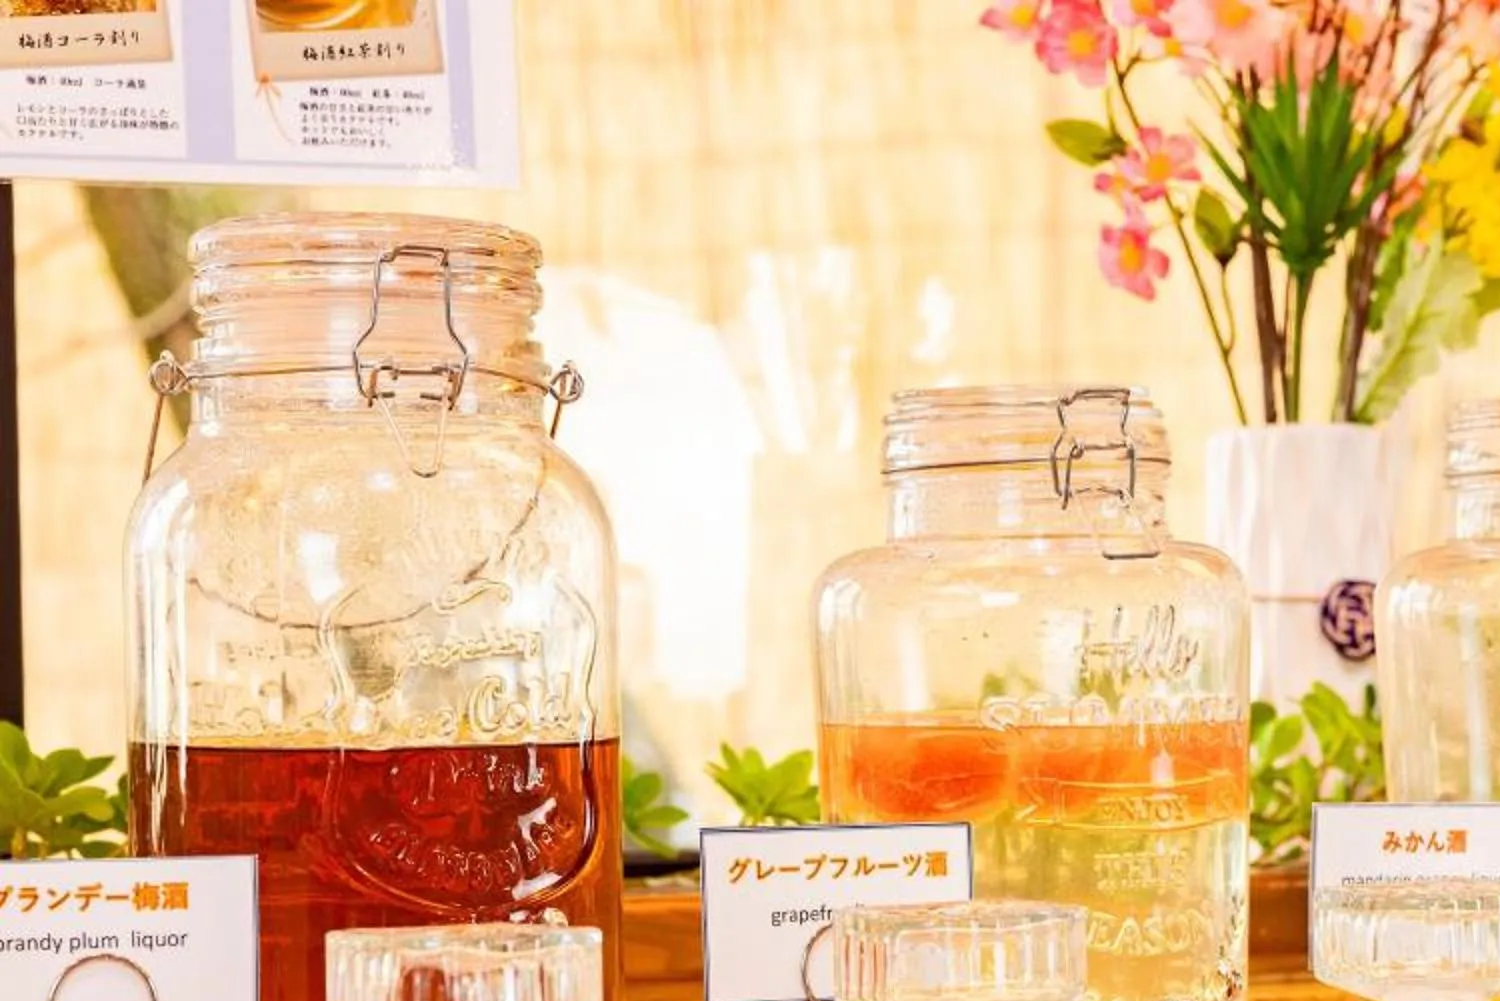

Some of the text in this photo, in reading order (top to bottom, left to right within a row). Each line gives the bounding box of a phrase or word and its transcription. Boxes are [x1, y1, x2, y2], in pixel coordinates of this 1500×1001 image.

[19, 30, 140, 49] 梅酒コーラ割り
[303, 42, 405, 61] 梅酒紅茶割り
[1382, 830, 1468, 853] みかん酒
[728, 852, 948, 883] グレープフルーツ酒
[69, 931, 119, 954] plum
[130, 930, 188, 954] liquor
